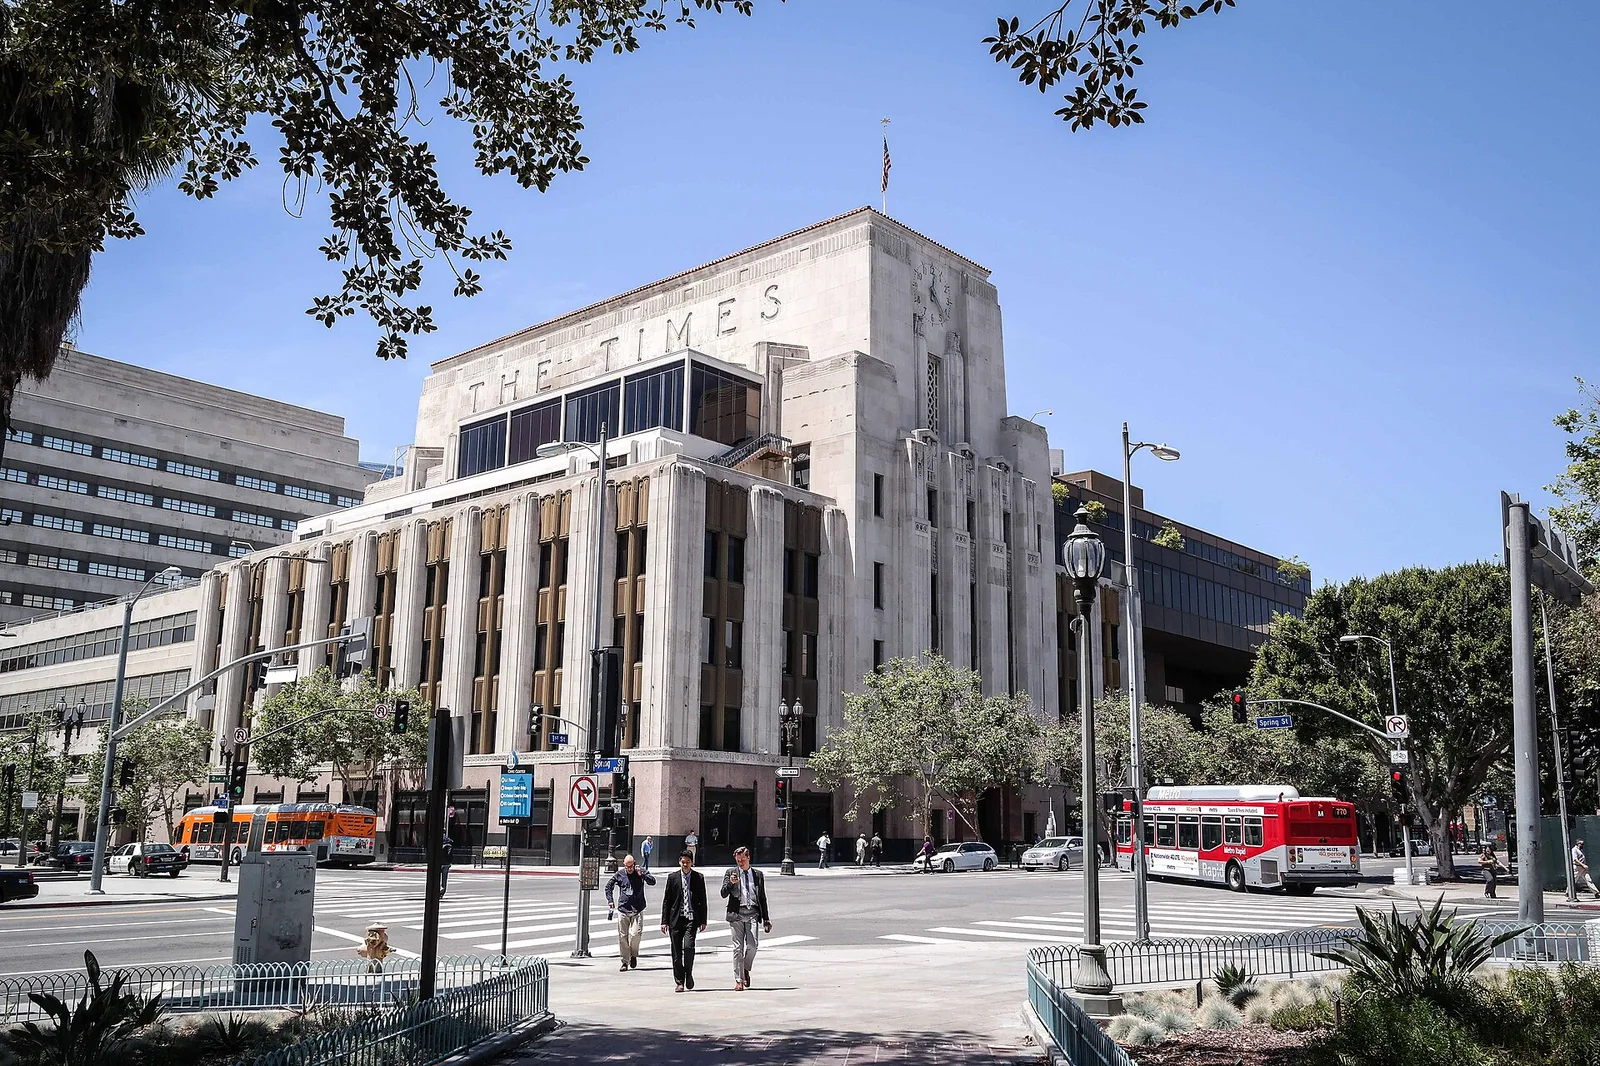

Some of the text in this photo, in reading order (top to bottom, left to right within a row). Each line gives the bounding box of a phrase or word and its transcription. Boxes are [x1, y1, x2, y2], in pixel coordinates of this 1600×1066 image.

[469, 284, 782, 413] THE TIMES
[594, 760, 610, 769] Spring
[1158, 788, 1180, 800] Metro
[1202, 862, 1224, 880] Rapid
